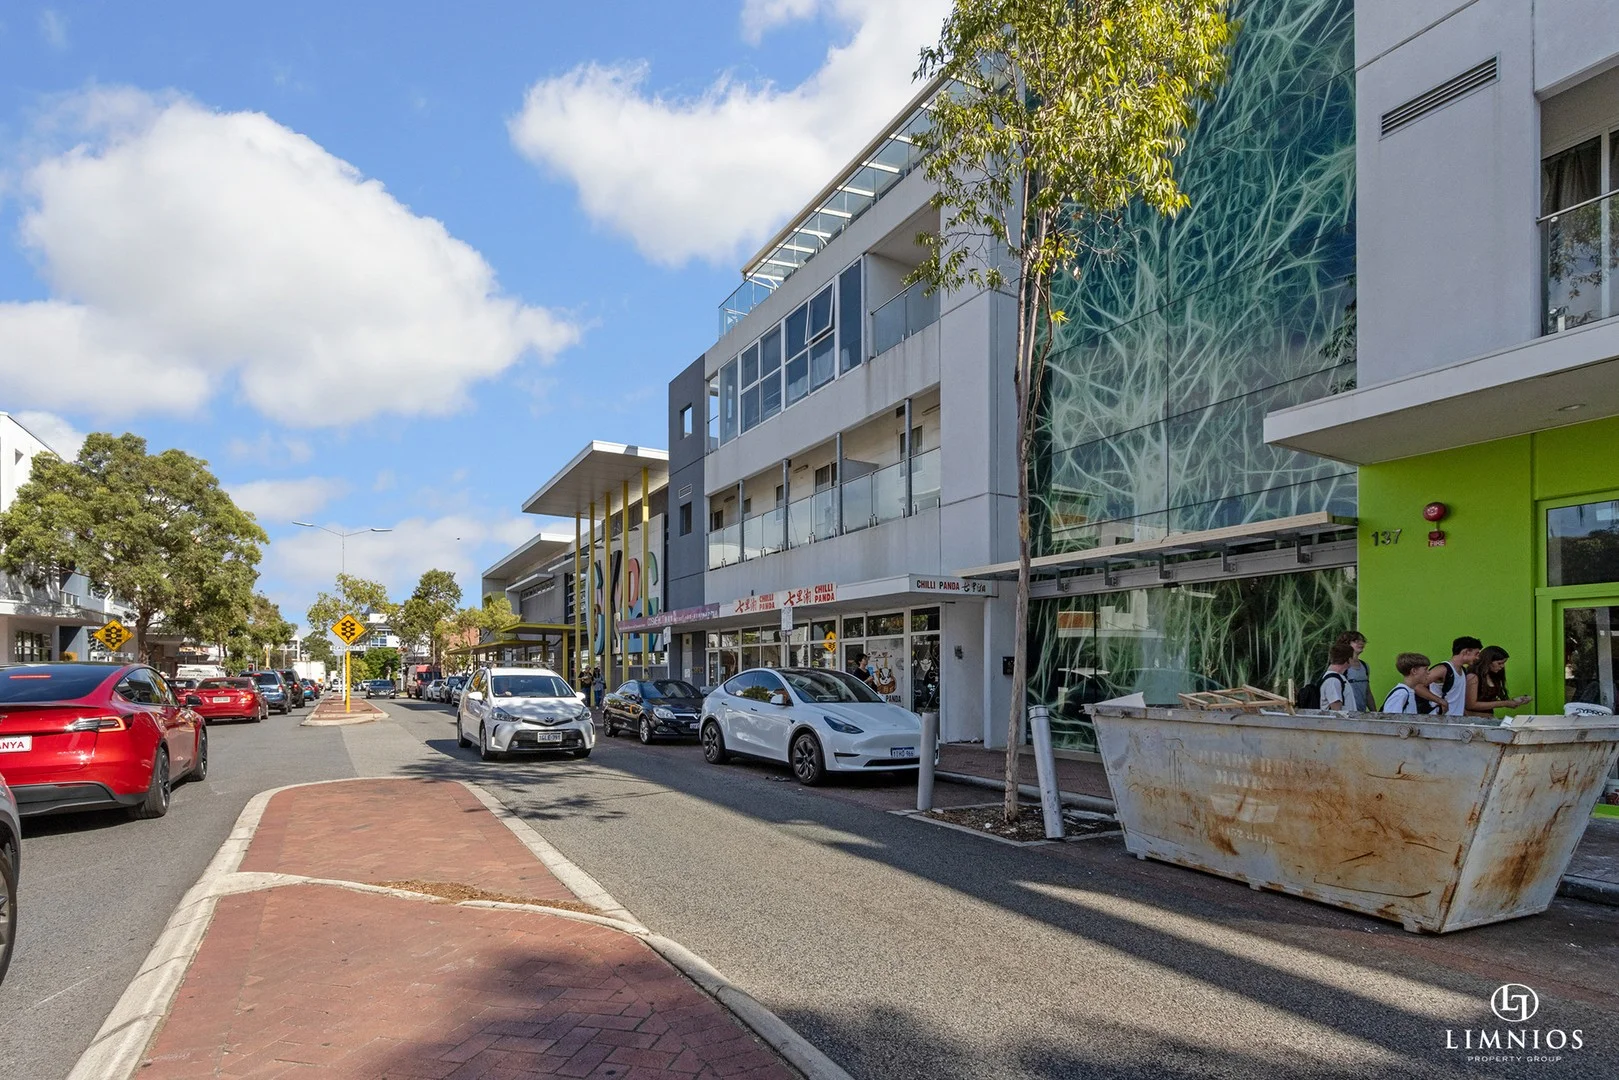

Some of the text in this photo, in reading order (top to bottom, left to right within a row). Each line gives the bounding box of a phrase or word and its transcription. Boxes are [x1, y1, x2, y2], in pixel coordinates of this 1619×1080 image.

[1371, 528, 1402, 546] 137
[814, 583, 834, 594] CHILLI
[916, 579, 960, 591] CHILLI PANDA
[759, 593, 774, 603] CHILLI
[814, 592, 835, 603] PANDA
[759, 601, 775, 611] PANDA
[0, 741, 25, 750] NYA
